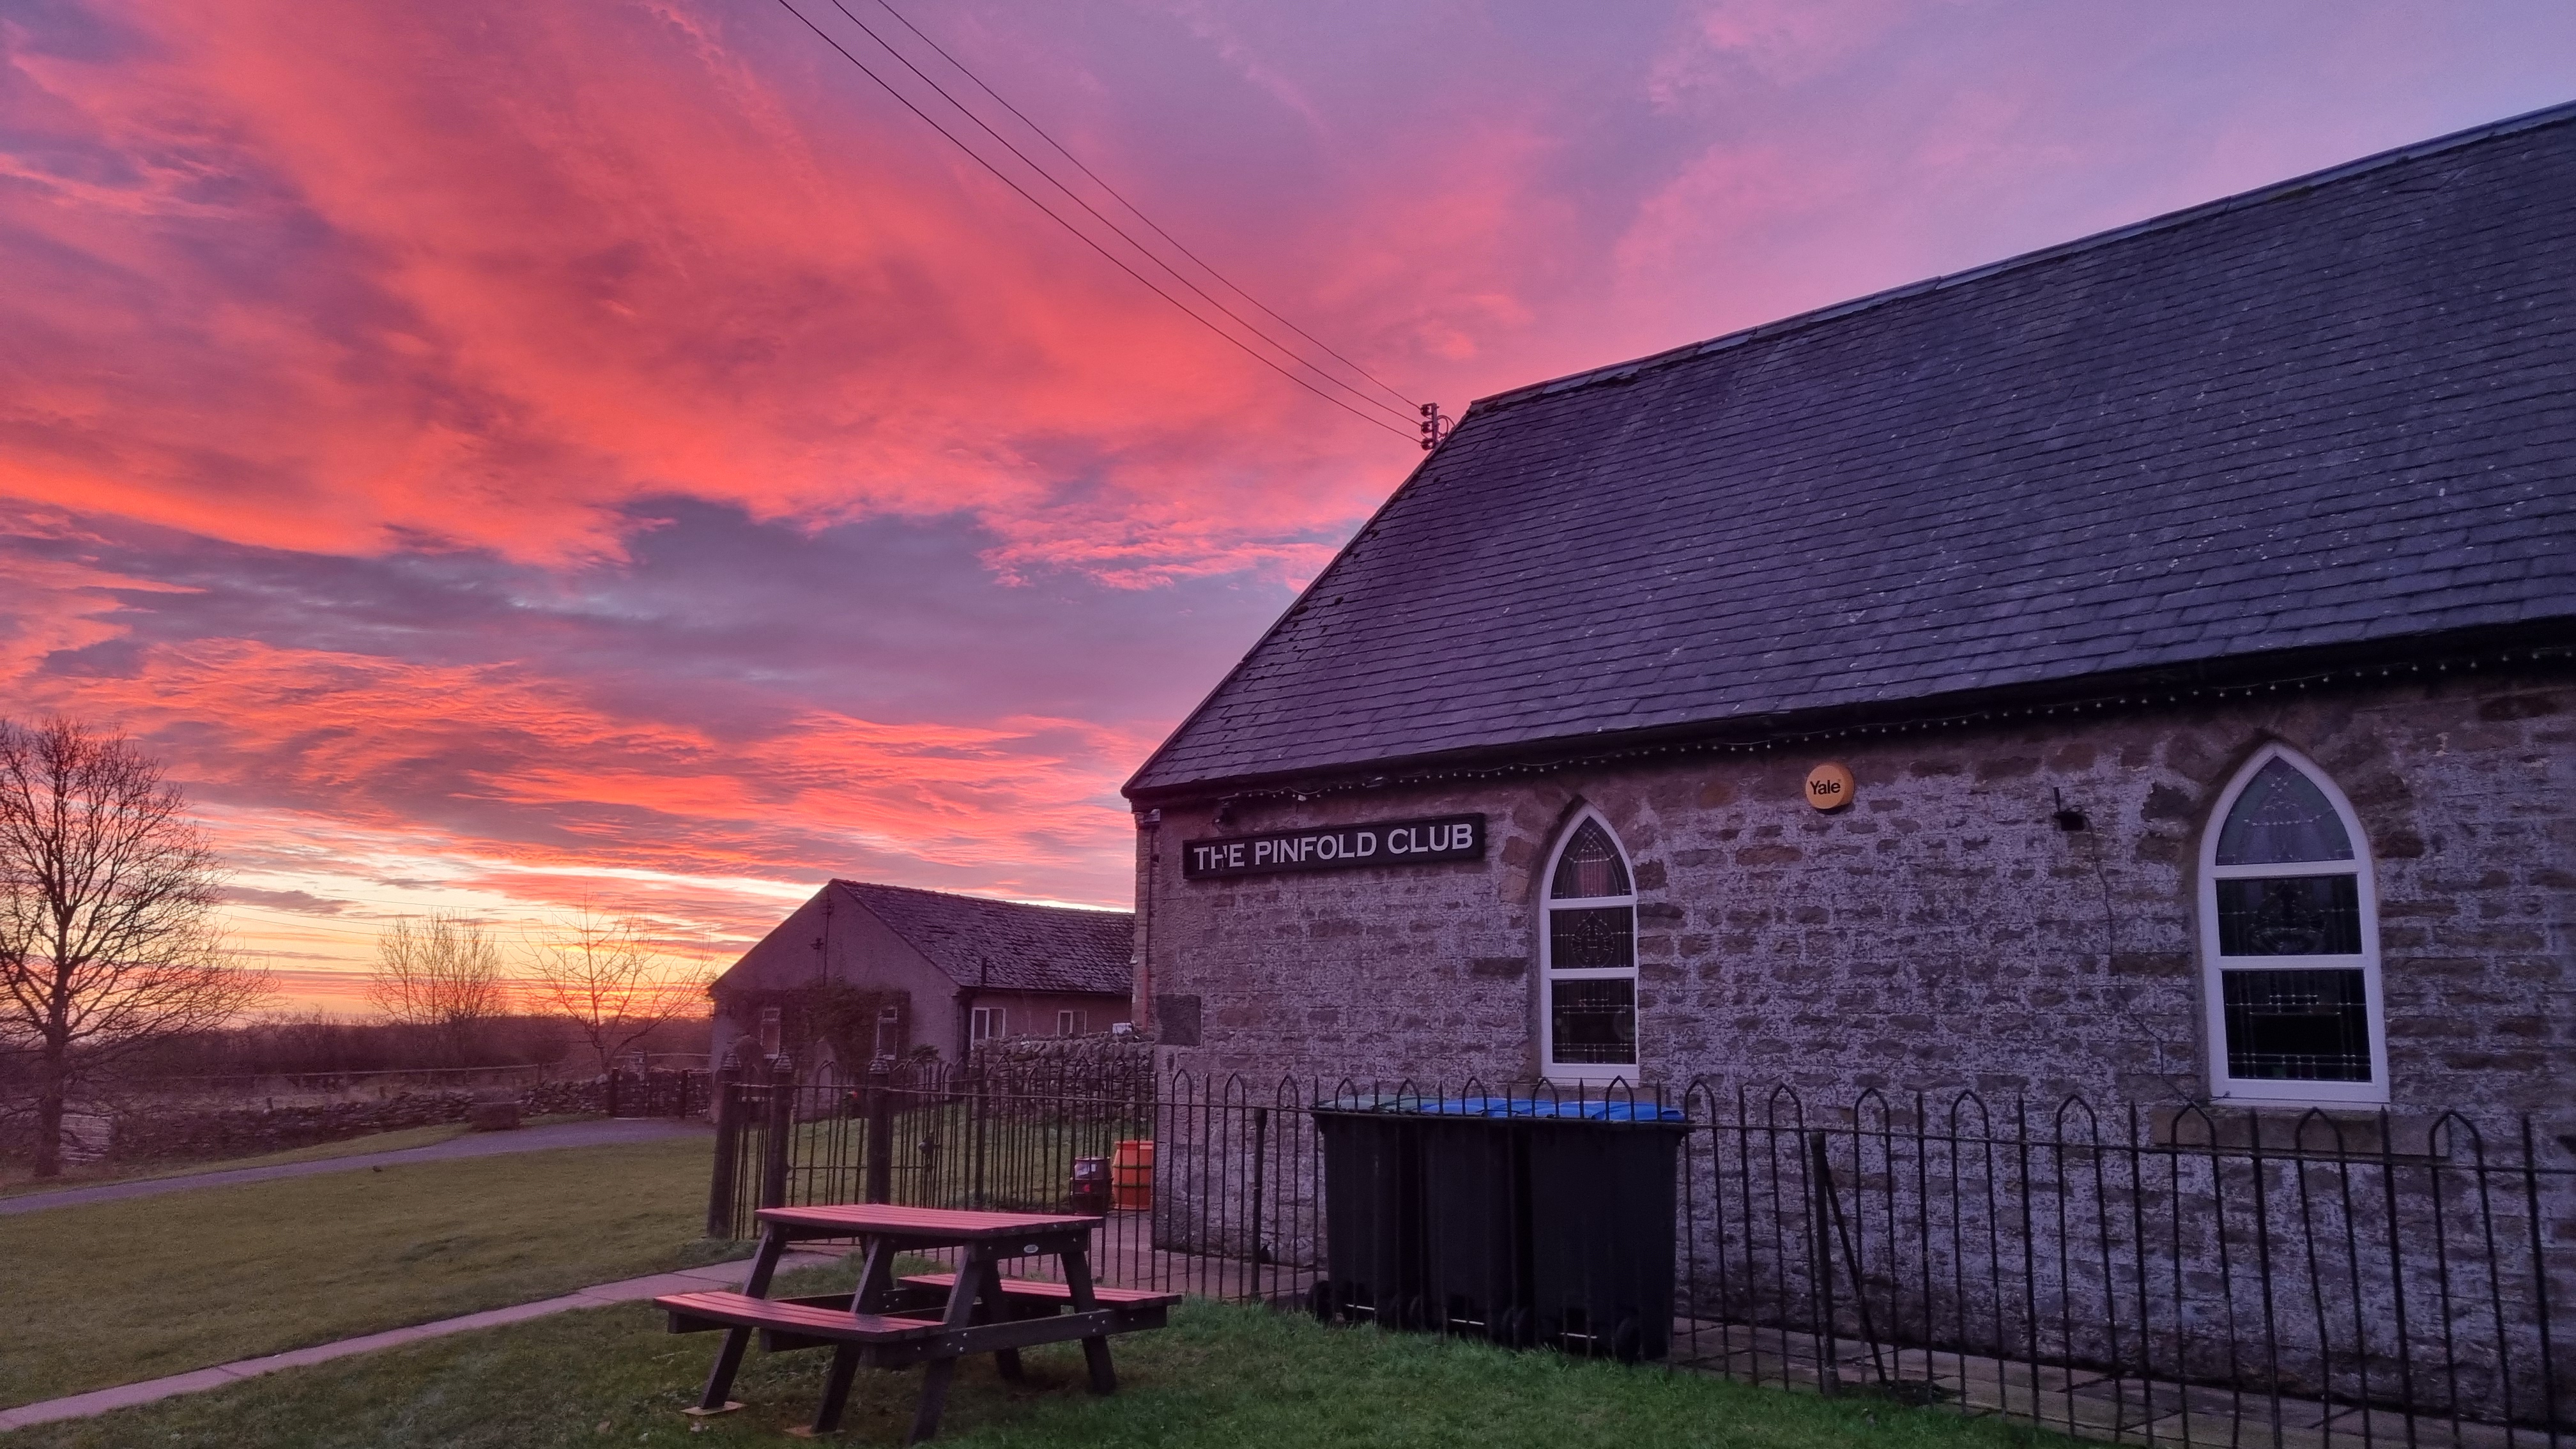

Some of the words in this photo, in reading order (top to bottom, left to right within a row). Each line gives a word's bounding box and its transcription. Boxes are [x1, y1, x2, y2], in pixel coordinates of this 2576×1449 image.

[1810, 780, 1841, 795] Yale
[1193, 843, 1245, 870] THE
[1255, 832, 1377, 865] PINFOLD
[1388, 824, 1473, 854] CLUB
